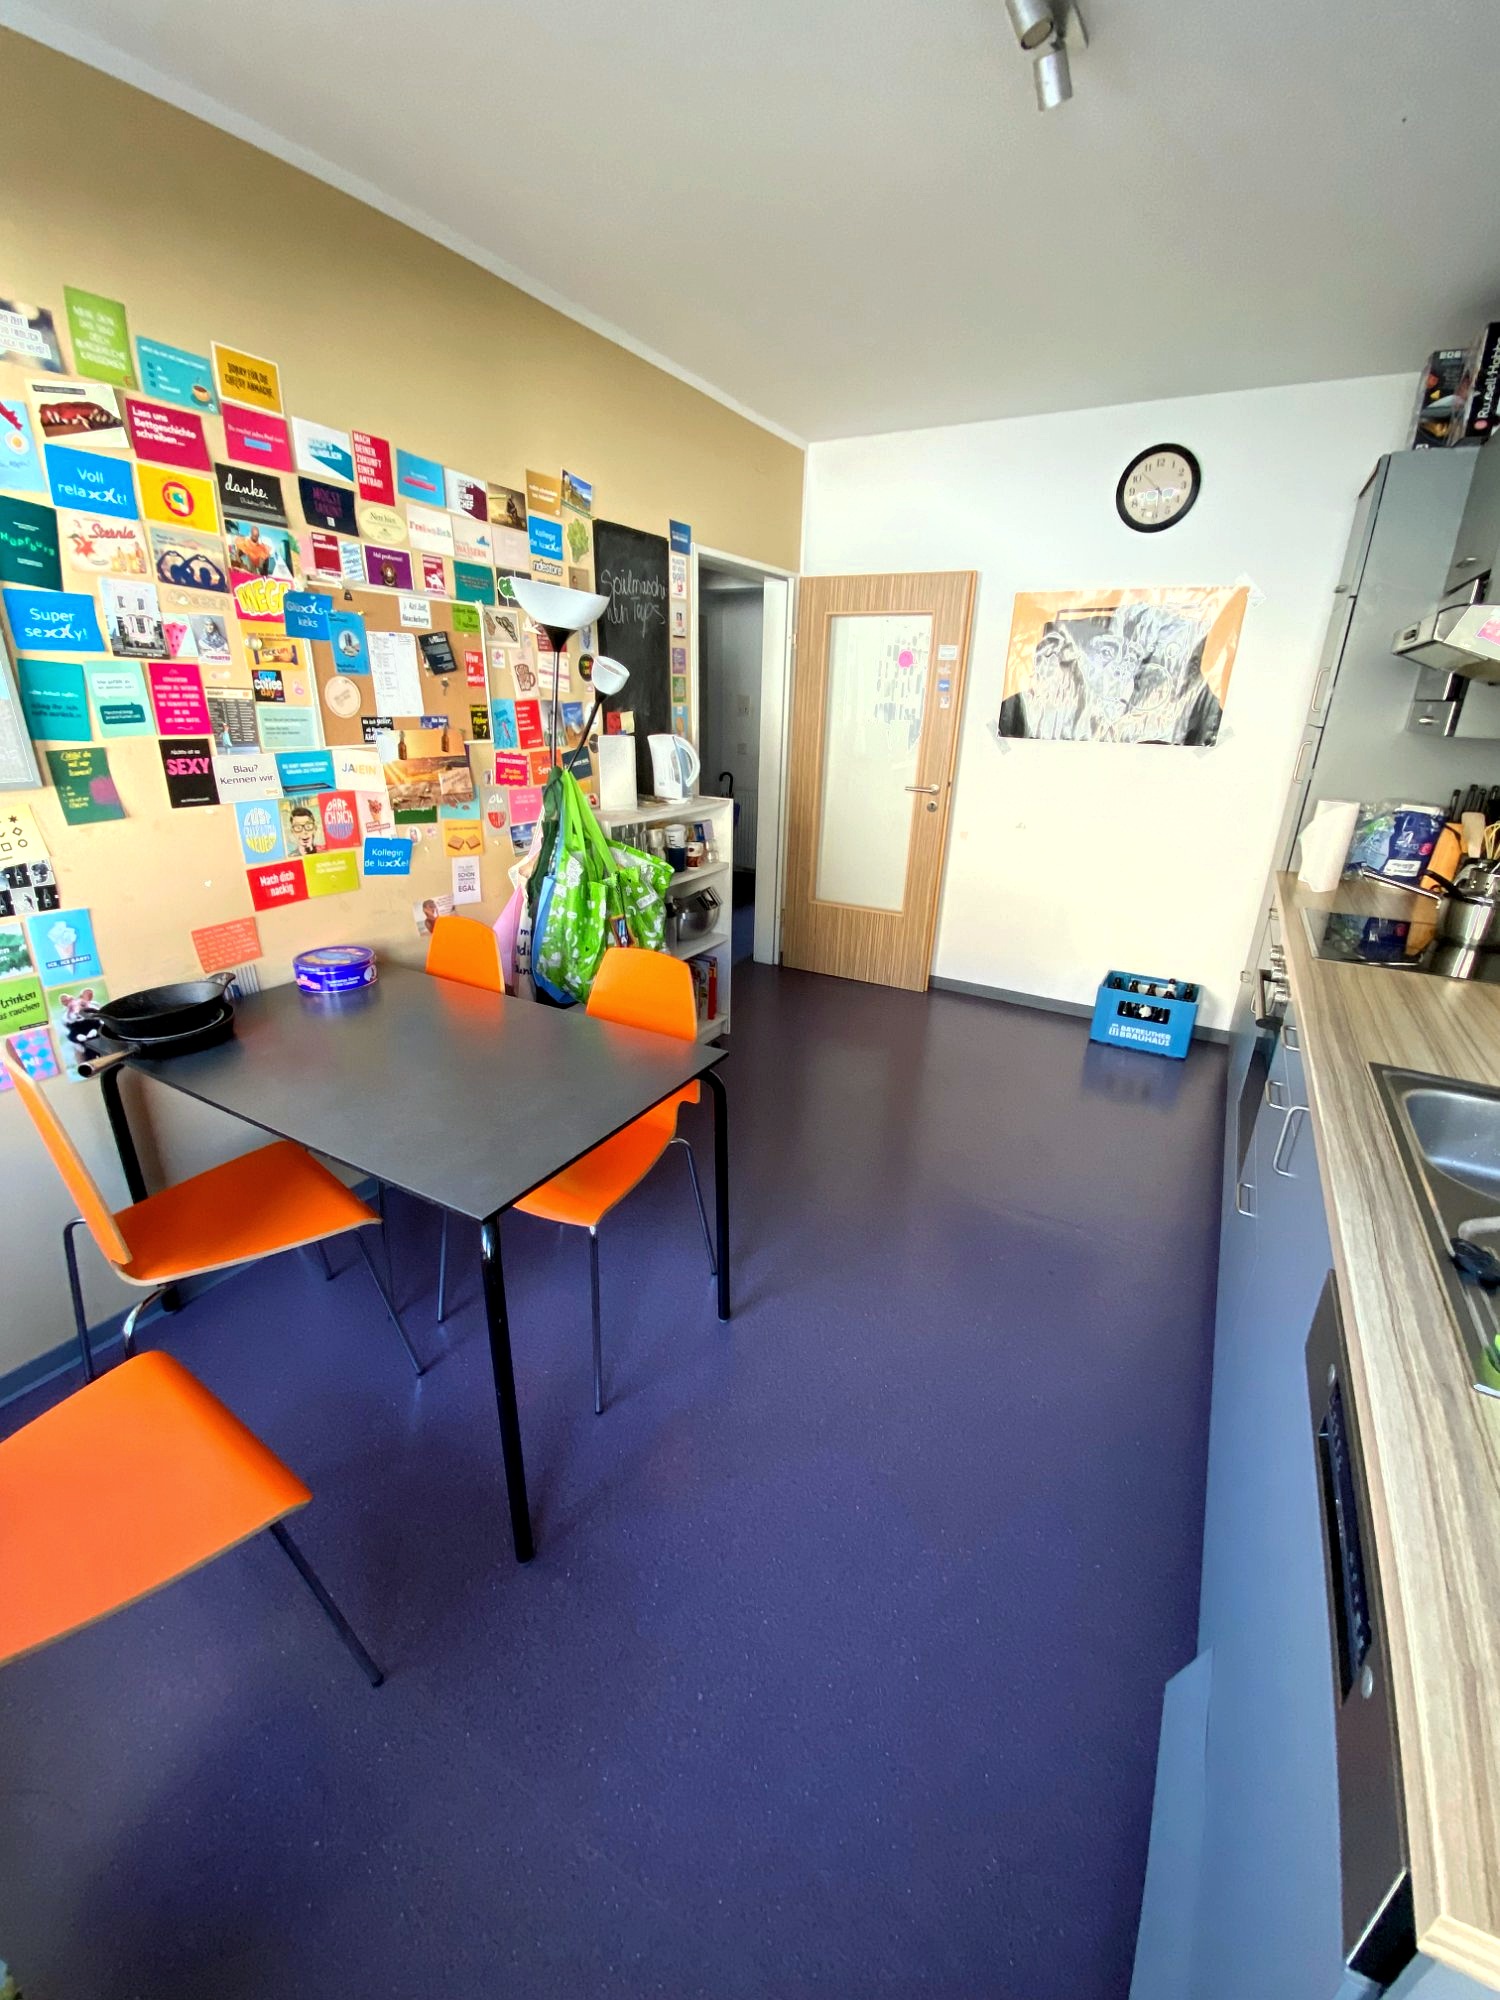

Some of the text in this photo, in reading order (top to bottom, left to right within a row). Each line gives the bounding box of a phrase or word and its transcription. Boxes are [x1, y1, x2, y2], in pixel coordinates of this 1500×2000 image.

[132, 405, 169, 423] Lass uns
[353, 431, 371, 444] MACH
[355, 442, 376, 456] DEINER
[356, 454, 382, 468] ZUKUNFT
[77, 466, 104, 484] Voll
[29, 607, 76, 624] Super
[298, 615, 319, 628] keks
[166, 757, 209, 776] SEXY
[233, 764, 258, 775] Blau?
[220, 774, 275, 785] Kennen wir.
[371, 847, 404, 860] Kollegin
[364, 859, 375, 867] de
[259, 870, 295, 887] Mach dich
[270, 883, 295, 897] nackig
[458, 885, 476, 893] EGAL
[9, 1001, 40, 1017] rauchen
[1119, 1031, 1171, 1047] BRAUHAUS
[1120, 1025, 1172, 1040] BAYREUTHER
